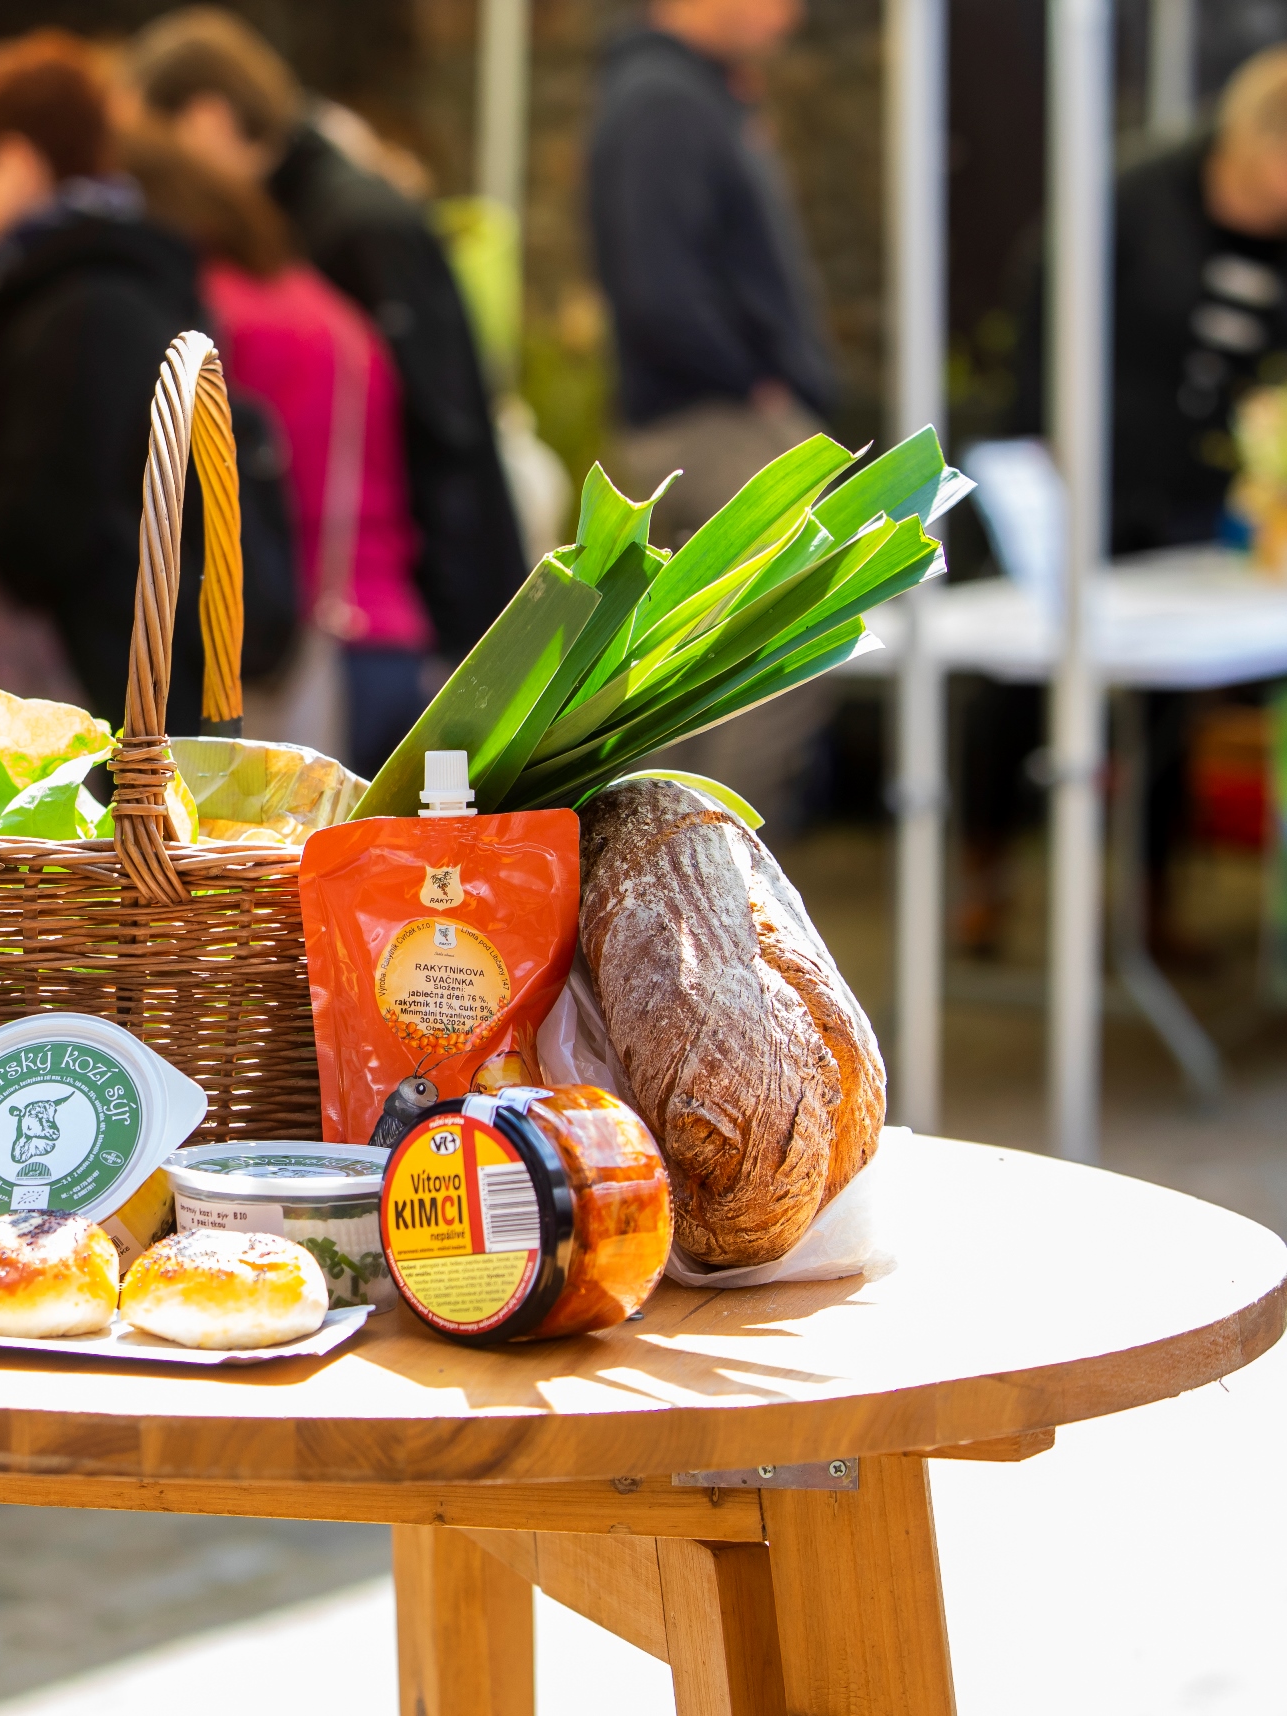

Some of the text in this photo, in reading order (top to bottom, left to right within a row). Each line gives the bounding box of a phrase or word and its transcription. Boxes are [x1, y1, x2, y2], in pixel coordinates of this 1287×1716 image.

[415, 962, 485, 978] RAKYTNÍKOVA
[478, 939, 491, 951] pod
[501, 977, 510, 991] 147
[425, 974, 475, 987] SVAČINKA
[433, 983, 466, 993] Složení:
[407, 989, 444, 999] jablečná
[446, 992, 465, 1002] dřeň
[467, 994, 477, 1003] 76
[394, 998, 431, 1009] rakytník
[458, 1003, 478, 1012] cukr
[400, 1007, 438, 1016] Minimální
[439, 1011, 478, 1021] trvanlivost
[419, 1016, 466, 1027] 30.03.2024
[60, 1046, 119, 1085] kozí
[103, 1085, 137, 1126] sýr
[411, 1169, 461, 1194] Vítovo
[217, 1210, 229, 1220] sýr
[233, 1211, 247, 1220] BIO
[394, 1194, 463, 1231] KIMCI
[197, 1219, 226, 1229] pažitkou
[430, 1227, 466, 1242] nepálivé
